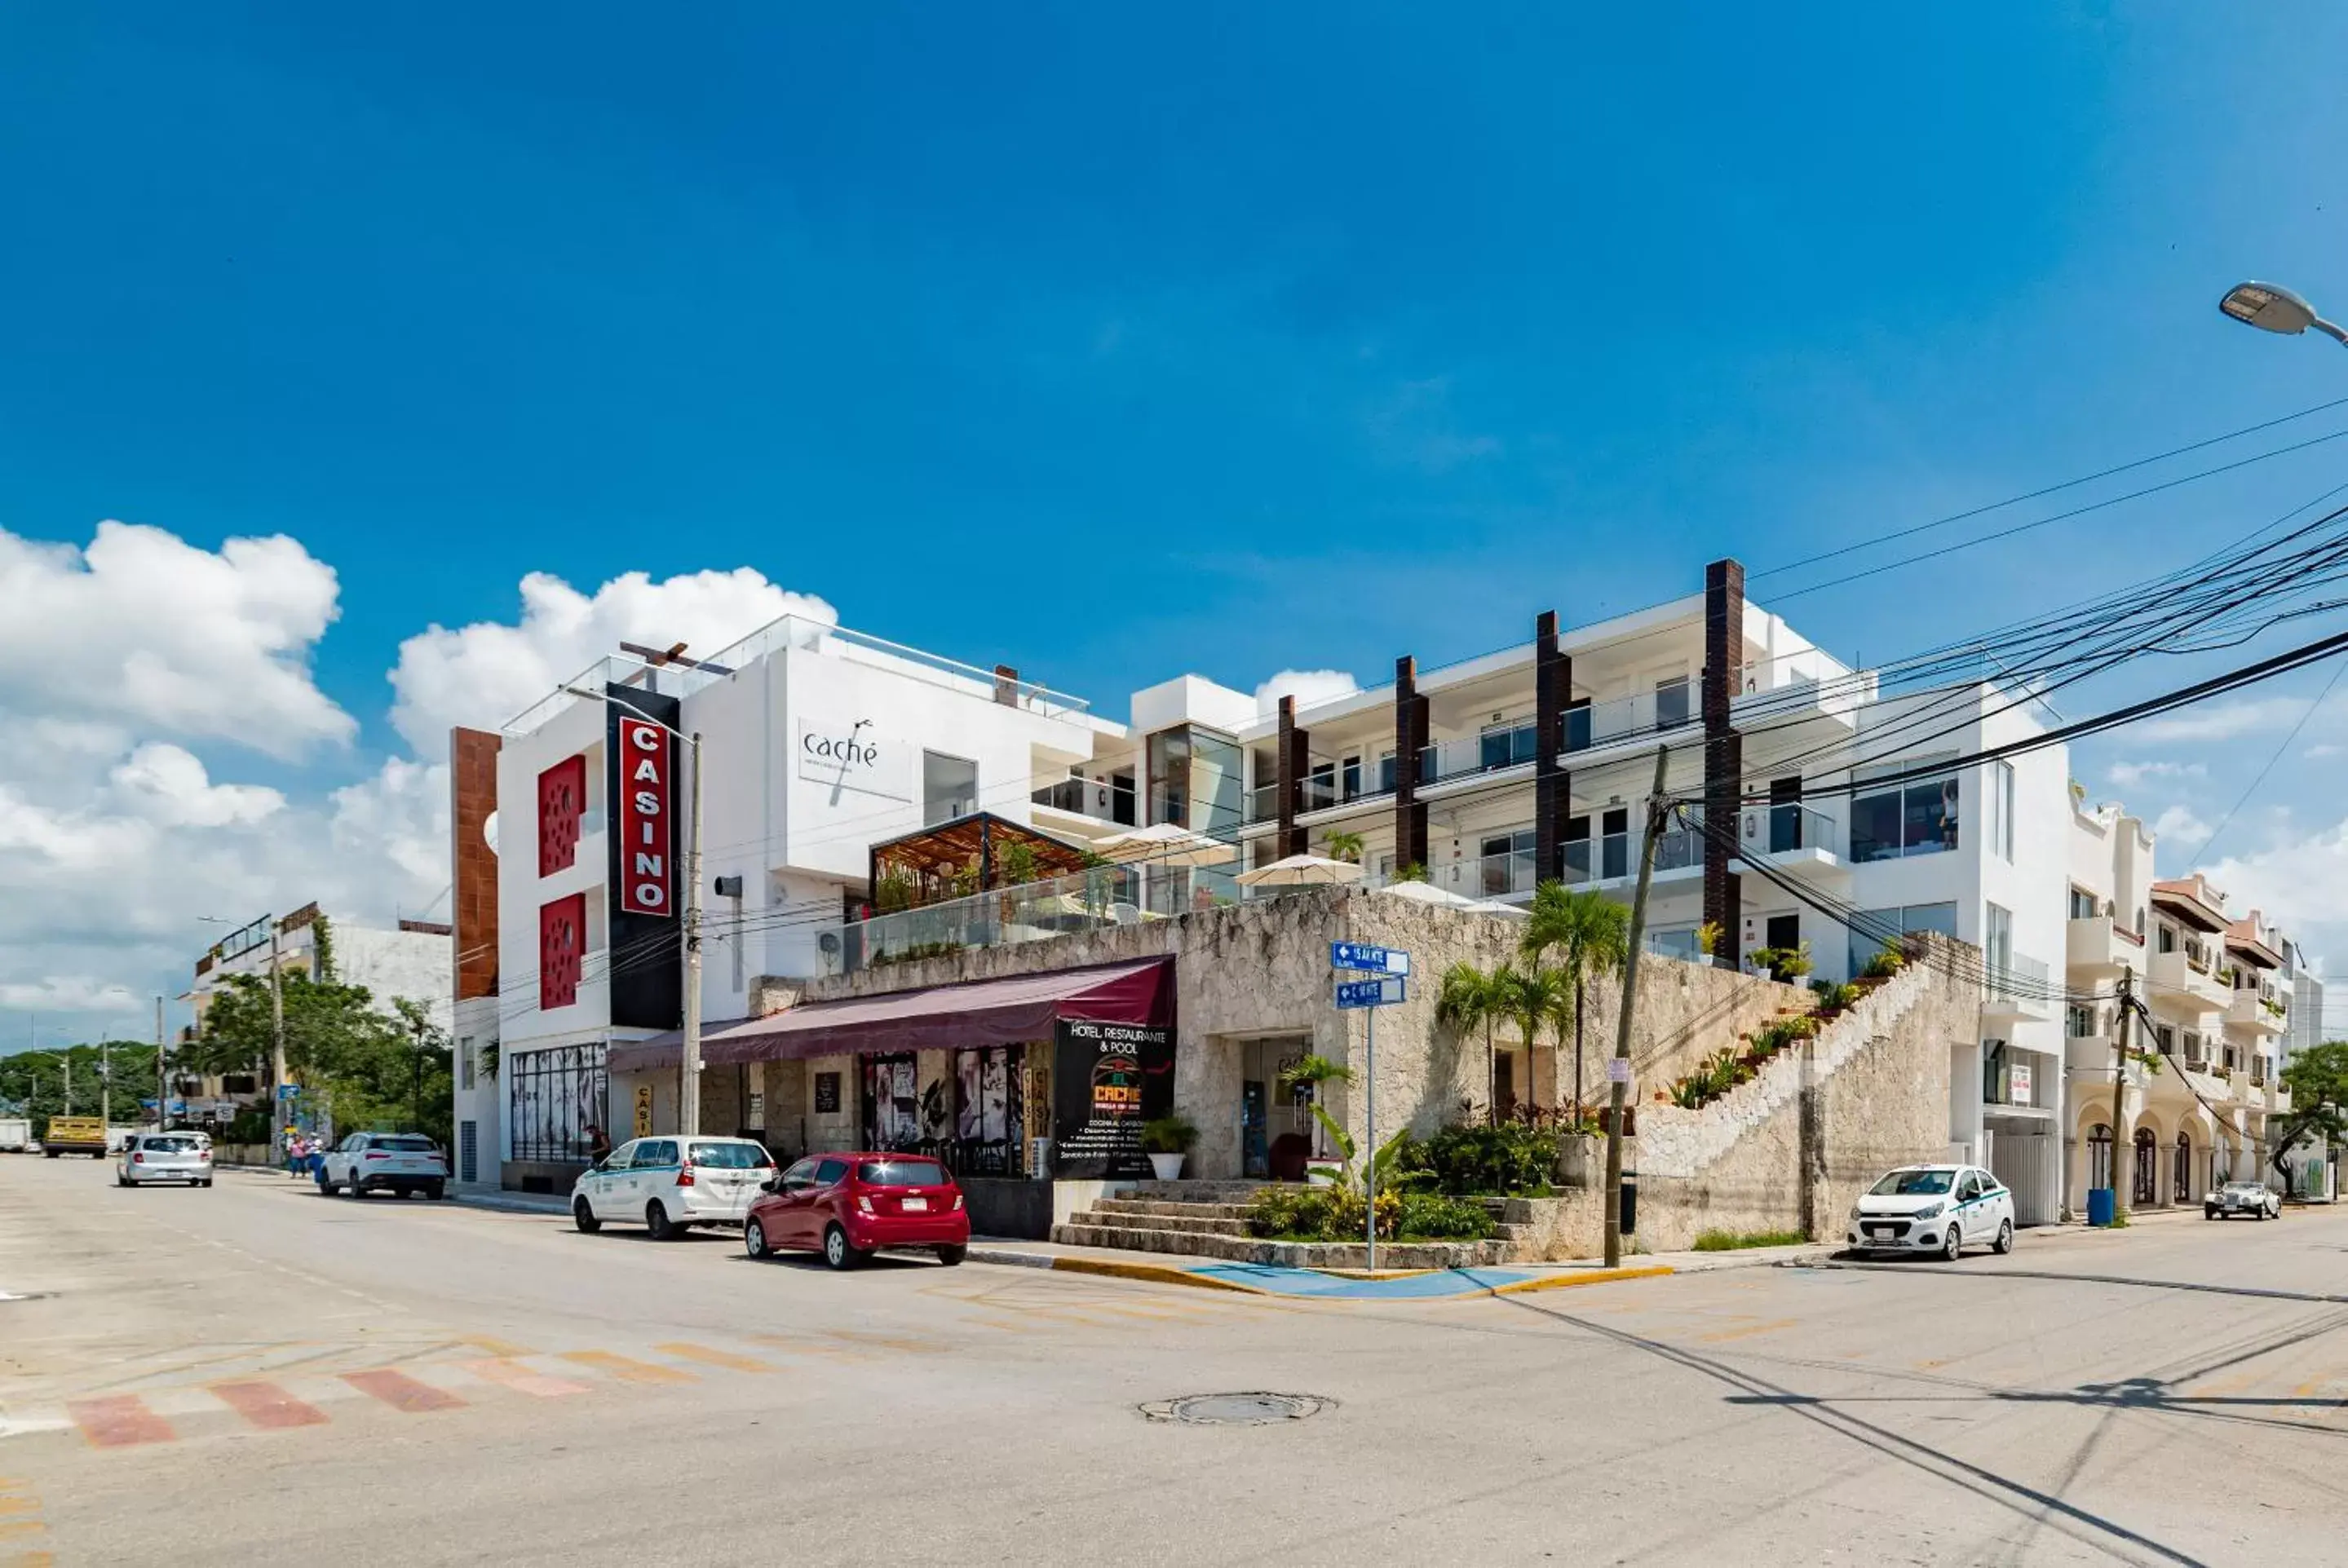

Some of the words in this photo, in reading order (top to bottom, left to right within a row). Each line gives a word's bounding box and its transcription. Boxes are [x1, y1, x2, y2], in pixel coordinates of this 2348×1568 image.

[804, 733, 877, 767] Caché
[632, 727, 664, 907] CASINO
[1099, 1041, 1108, 1052] &
[1111, 1043, 1138, 1054] POOL
[1104, 1027, 1165, 1043] RESTAURANTE
[639, 1088, 648, 1137] CASI
[1036, 1071, 1044, 1133] CASI
